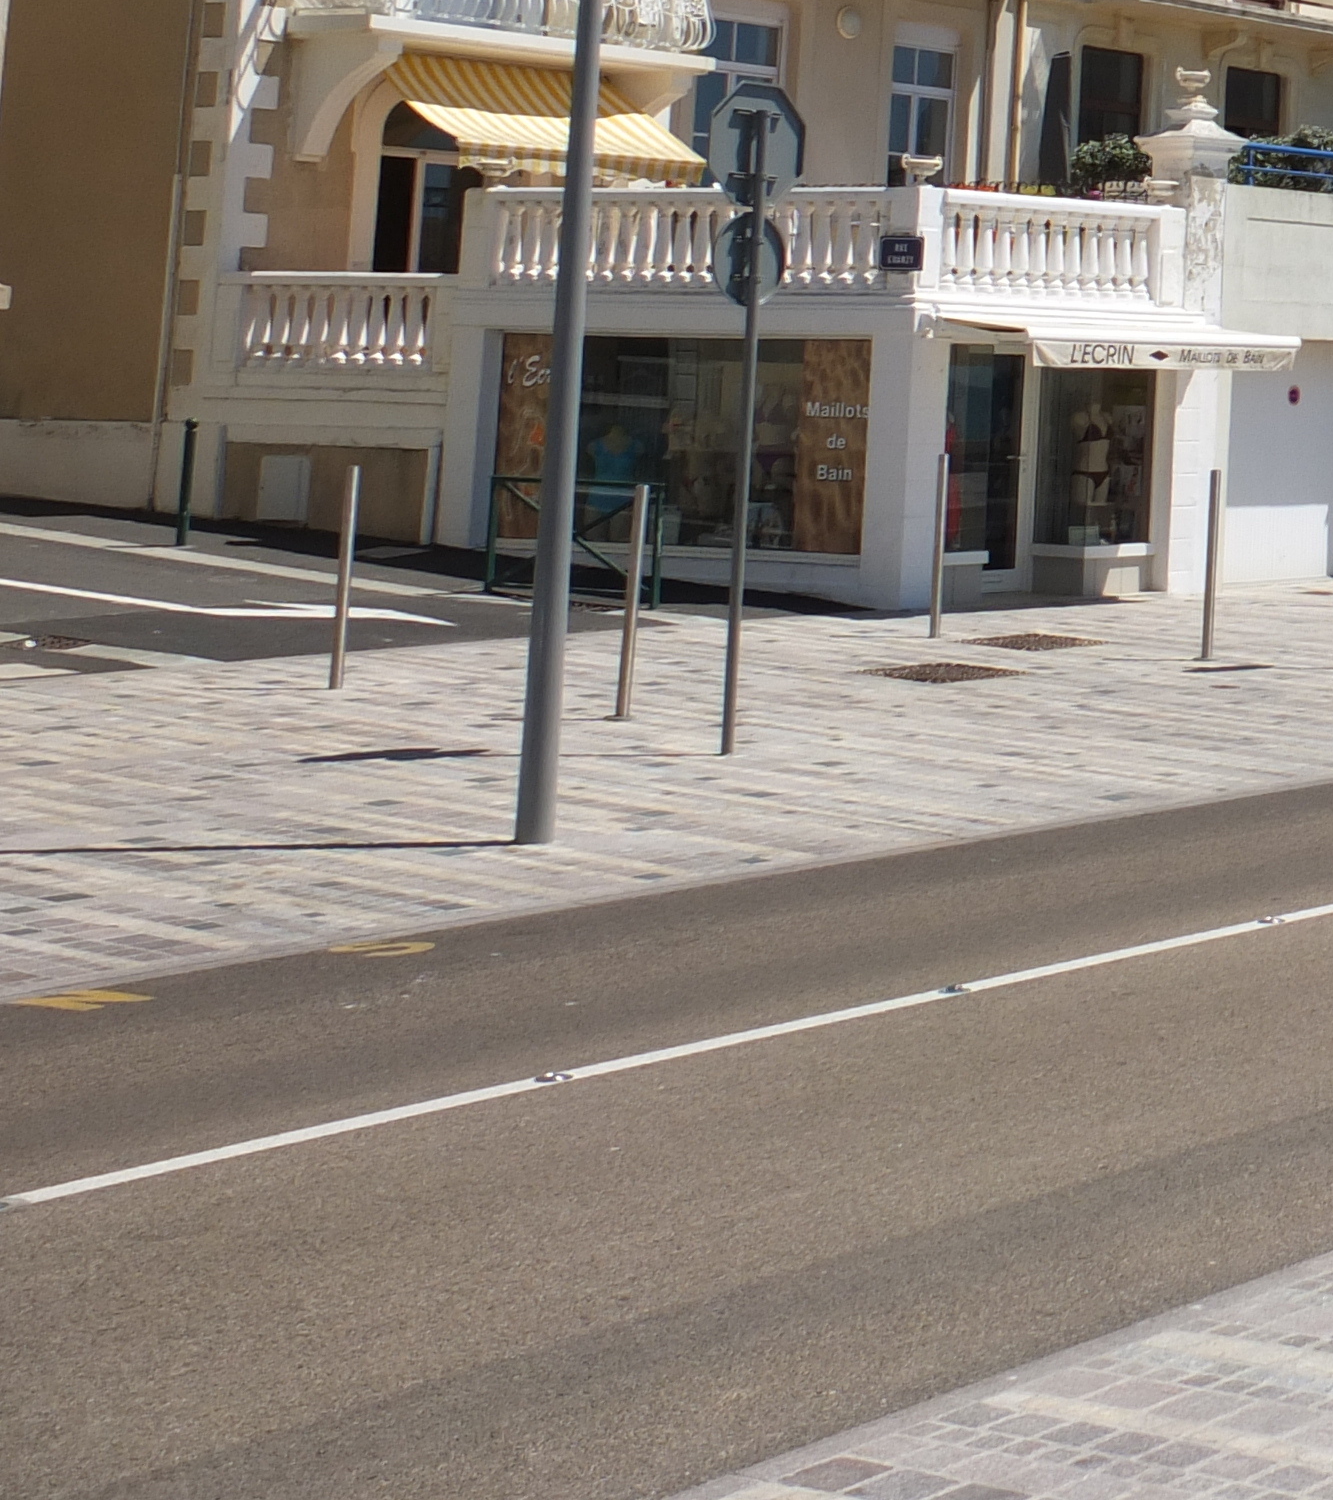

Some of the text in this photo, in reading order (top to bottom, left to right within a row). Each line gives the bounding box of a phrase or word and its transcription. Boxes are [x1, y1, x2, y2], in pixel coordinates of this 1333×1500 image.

[1069, 343, 1135, 365] L'ECRIN
[805, 402, 870, 418] Maillots
[826, 433, 847, 449] de
[816, 464, 853, 481] Bain
